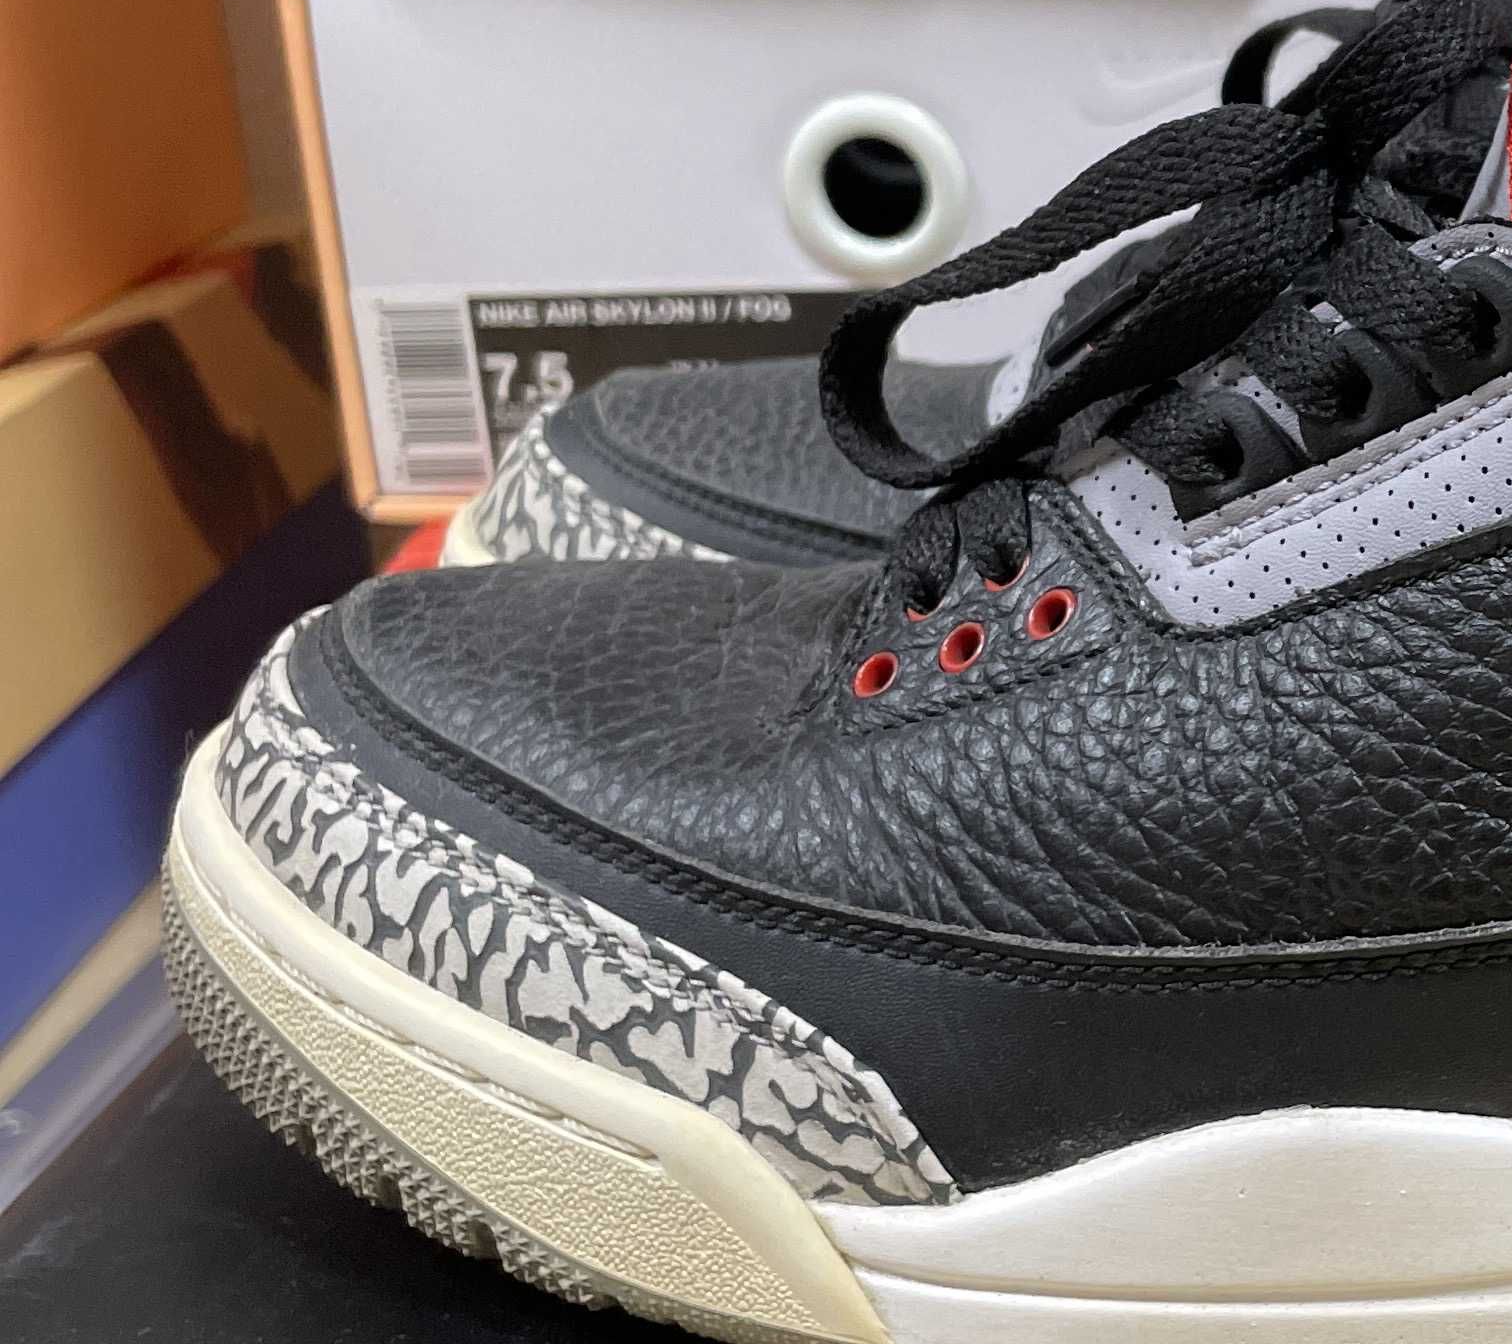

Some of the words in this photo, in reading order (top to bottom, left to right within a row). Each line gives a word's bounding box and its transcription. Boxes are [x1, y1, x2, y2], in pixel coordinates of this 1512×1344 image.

[478, 301, 538, 327] NIKE
[545, 300, 587, 327] AIR
[592, 297, 696, 326] SKYLON
[483, 351, 573, 406] 7.5
